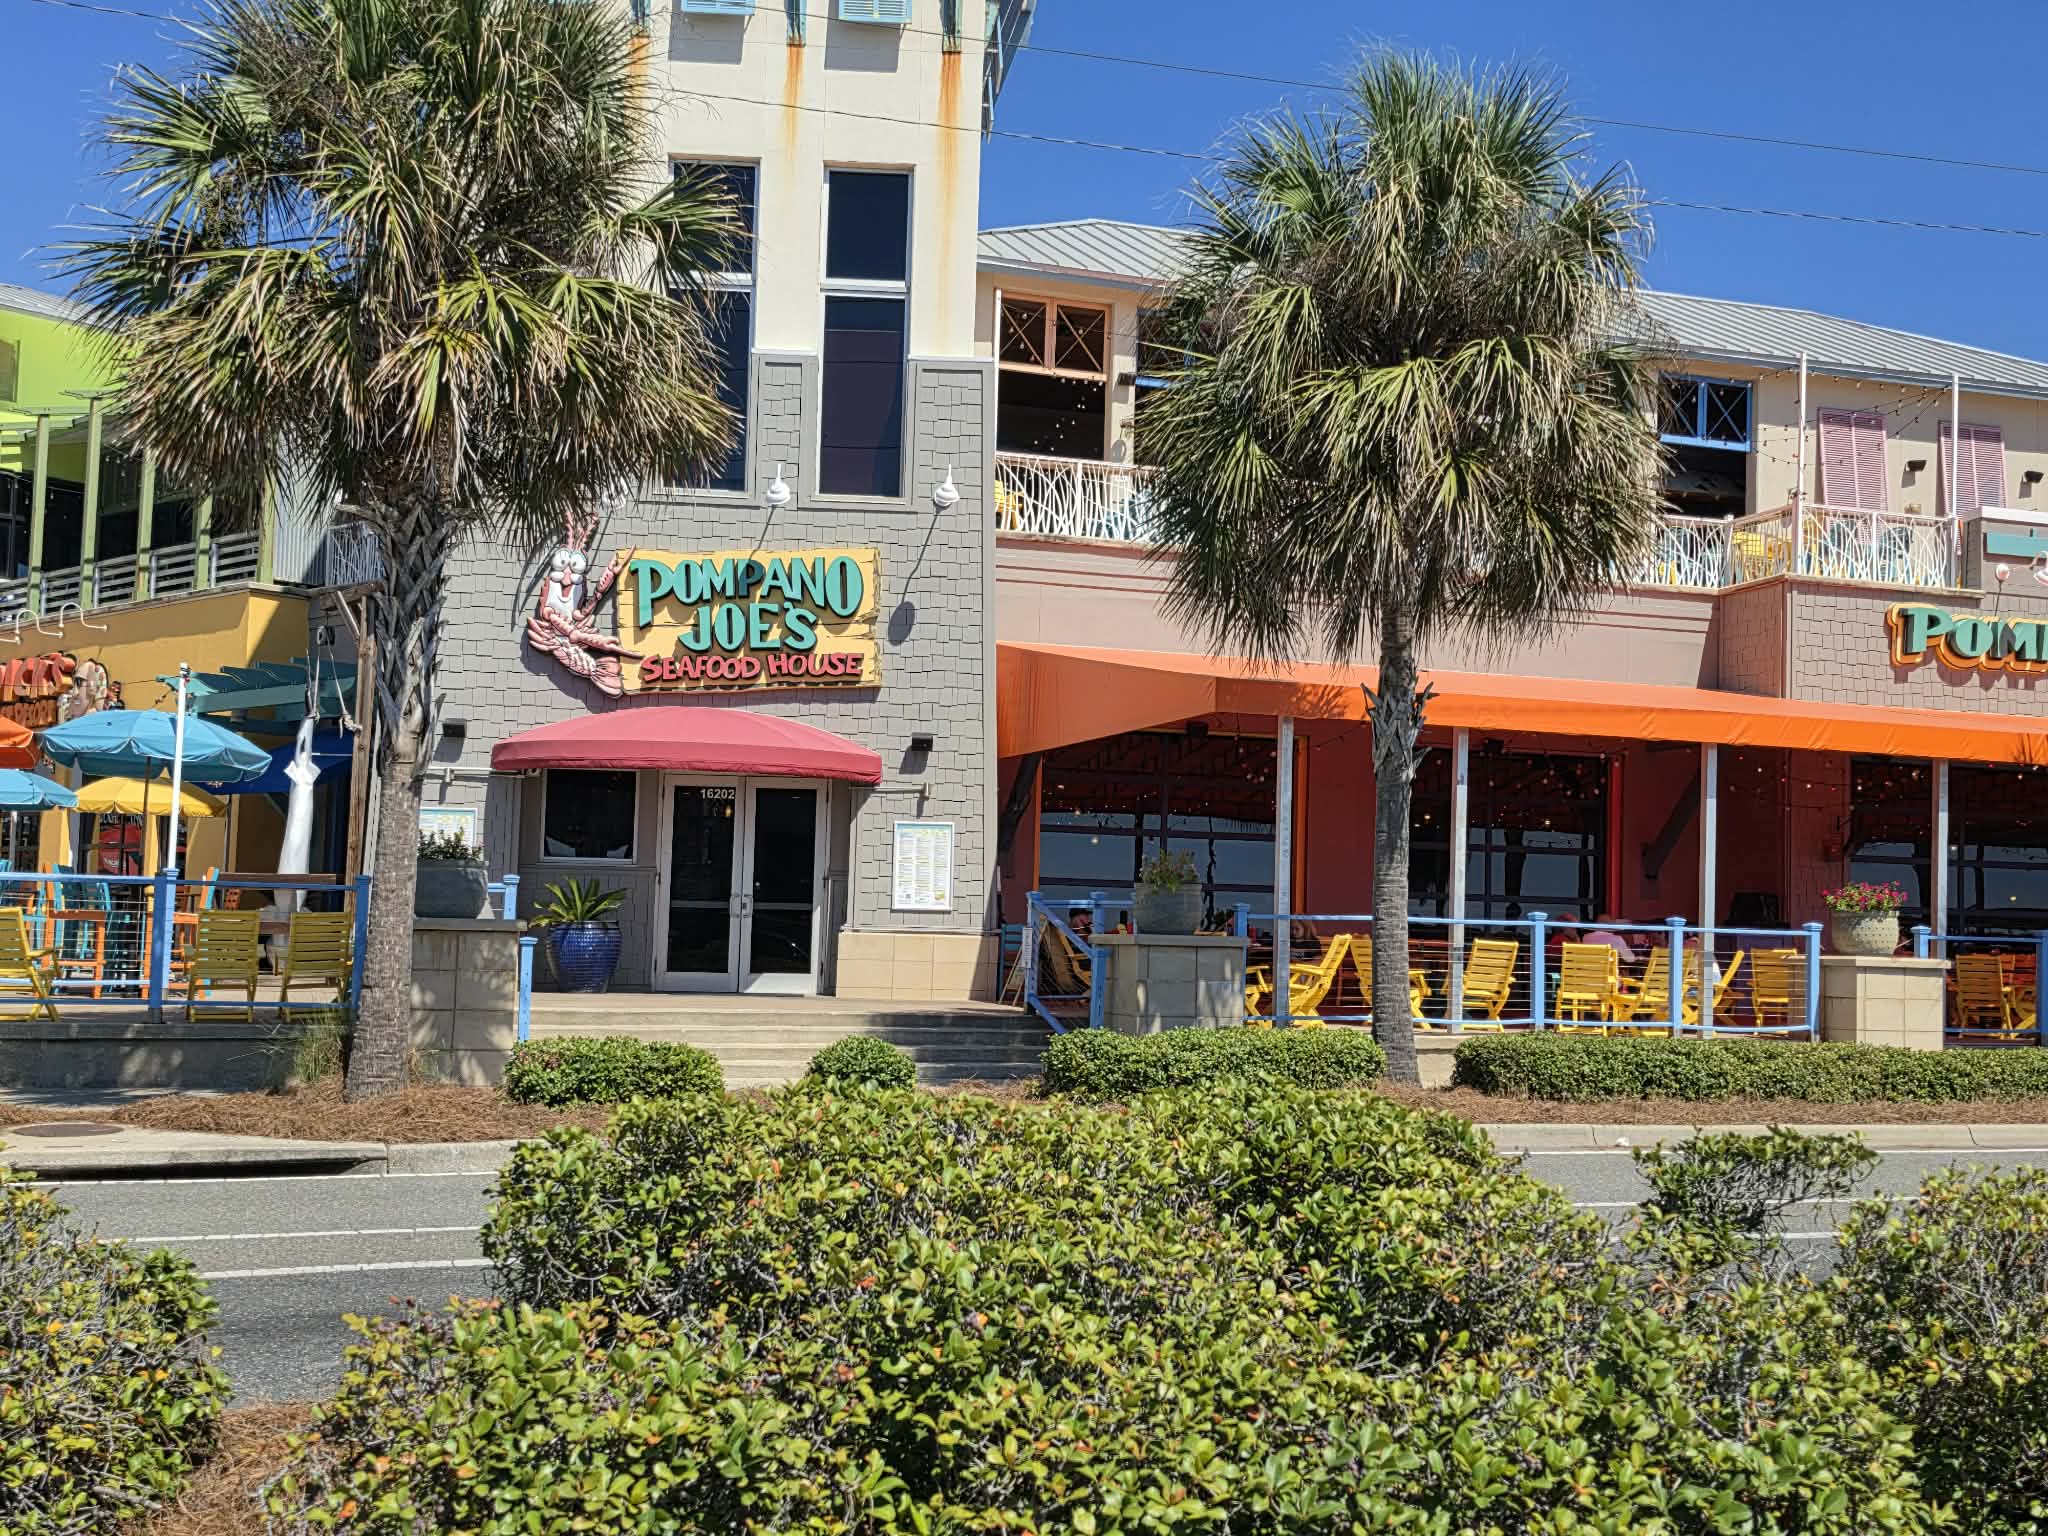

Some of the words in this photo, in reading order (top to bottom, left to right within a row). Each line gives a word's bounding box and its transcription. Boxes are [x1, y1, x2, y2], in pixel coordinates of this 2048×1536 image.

[629, 555, 864, 628] POMPANO
[677, 601, 817, 652] JOE'S
[1899, 606, 2048, 661] POM
[640, 654, 760, 683] SEAFOOD
[768, 652, 864, 678] HOUSE
[700, 788, 735, 799] 16202
